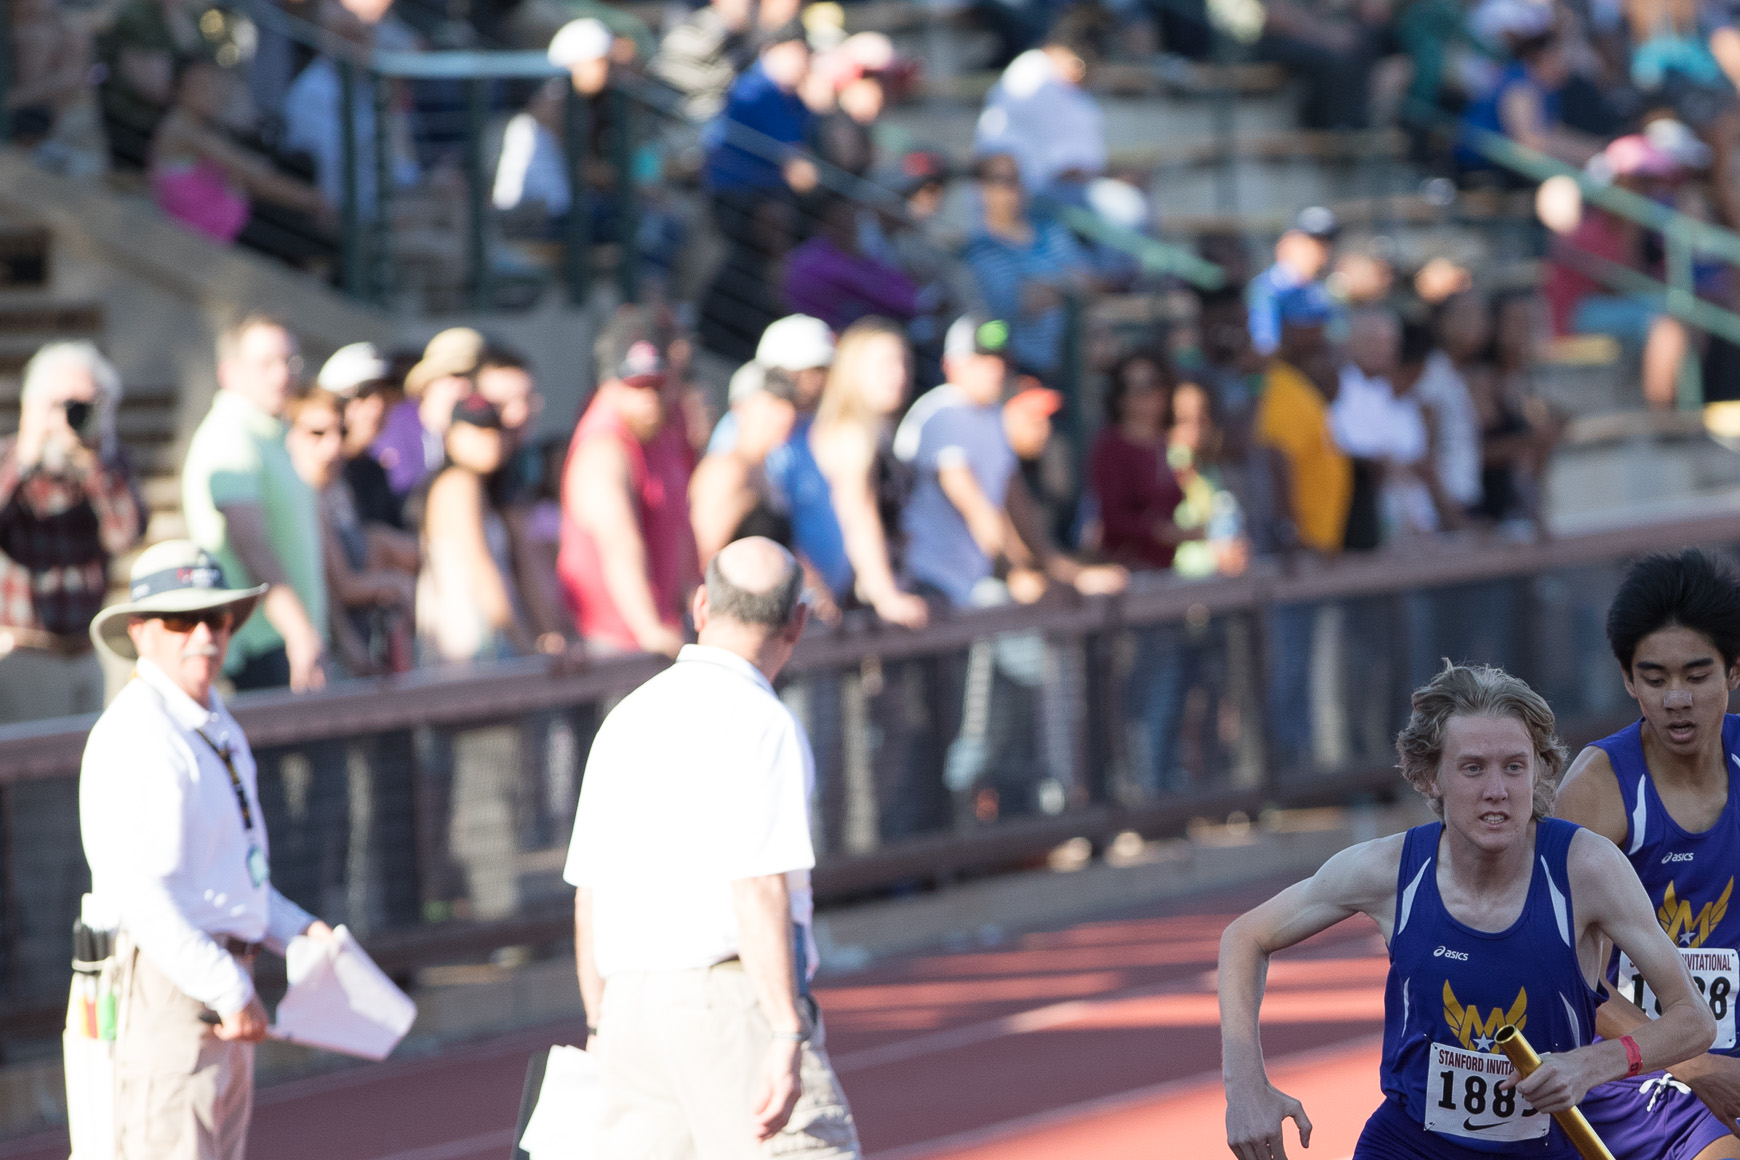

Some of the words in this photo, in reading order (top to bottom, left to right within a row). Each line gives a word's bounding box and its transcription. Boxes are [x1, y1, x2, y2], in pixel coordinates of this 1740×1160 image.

[1672, 853, 1694, 862] asics
[1445, 950, 1469, 961] asics
[1683, 954, 1732, 971] VITATIONAL
[1632, 974, 1731, 1021] 18
[1439, 1049, 1484, 1073] STANFORD
[1487, 1058, 1515, 1076] INVITA
